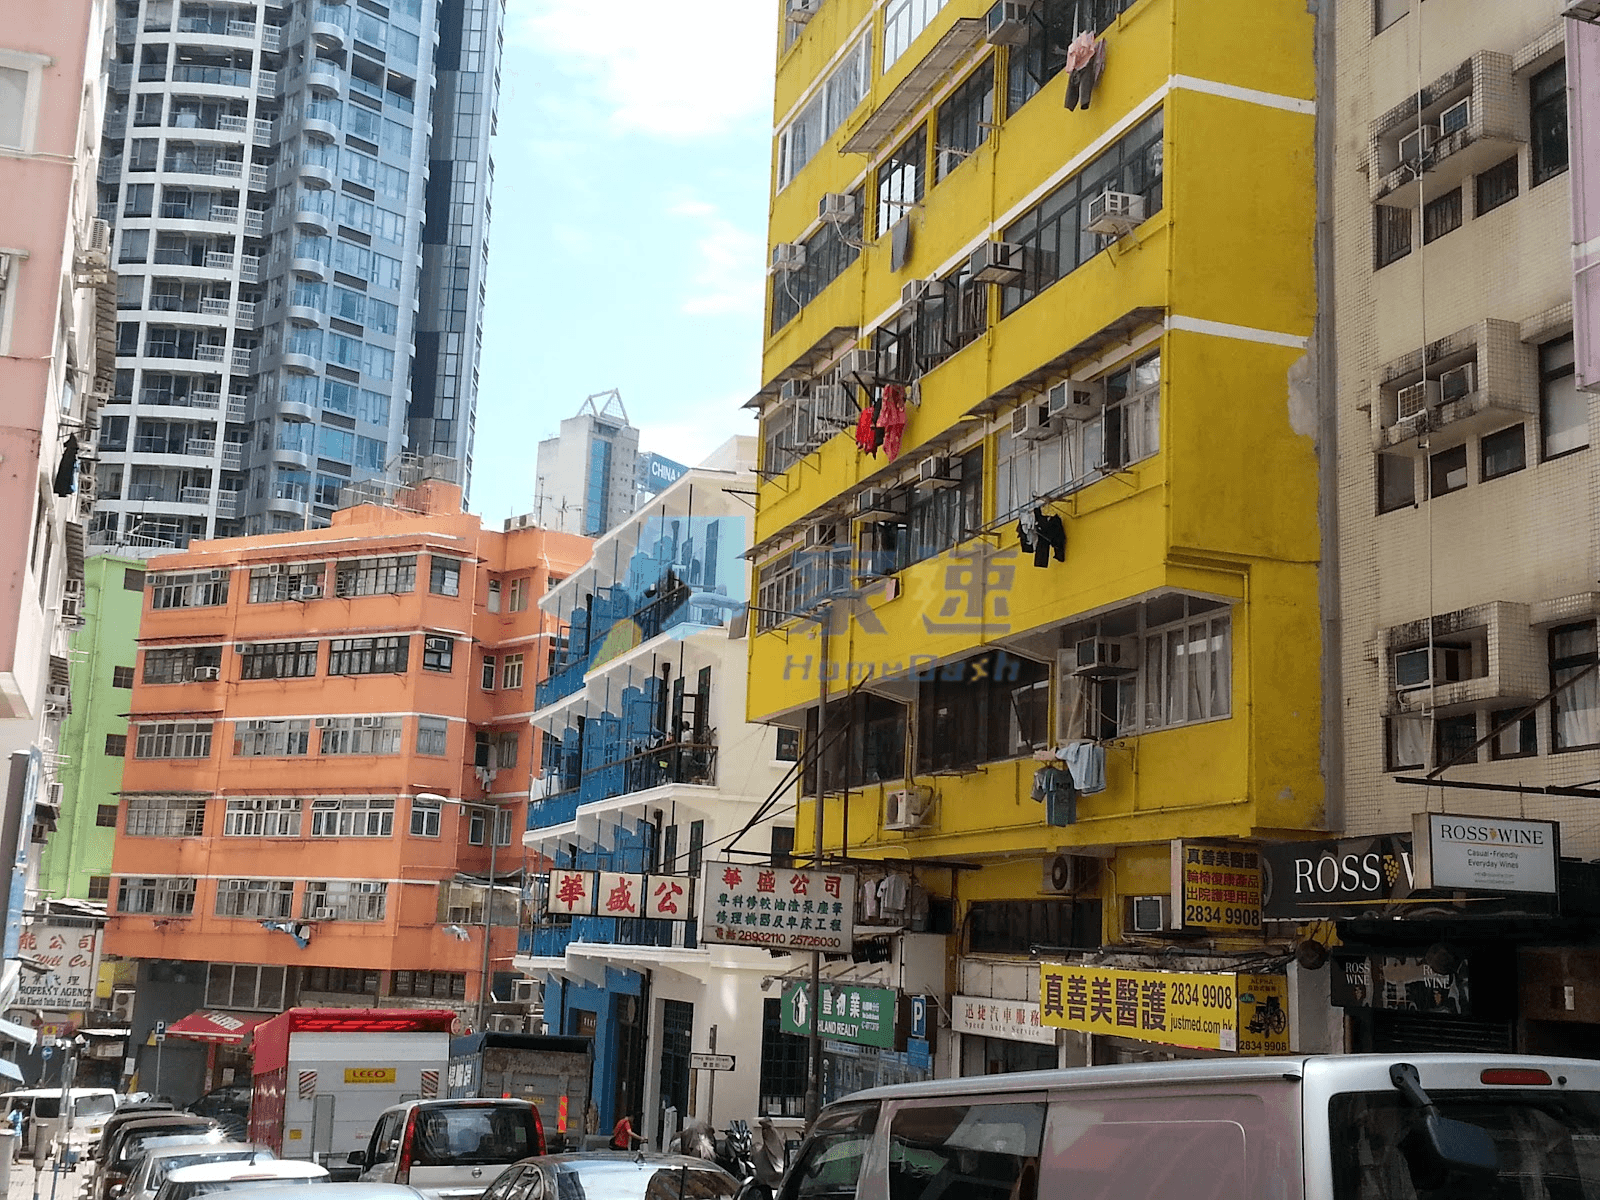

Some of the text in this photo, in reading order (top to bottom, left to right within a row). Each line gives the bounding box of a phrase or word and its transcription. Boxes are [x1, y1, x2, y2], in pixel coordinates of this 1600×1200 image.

[652, 461, 676, 482] CHINA
[1441, 824, 1544, 845] ROSS WINE
[1187, 848, 1260, 869] 真善美醫護
[1468, 859, 1519, 869] Everyday Wines
[722, 866, 842, 899] 華盛公司
[1294, 853, 1381, 894] ROSS
[555, 873, 684, 915] 華盛公
[1186, 905, 1260, 926] 2834 9908
[738, 930, 786, 944] 28932110
[790, 935, 841, 948] 25726030
[68, 954, 92, 968] Co.
[1345, 962, 1371, 974] ROSS
[1345, 973, 1371, 986] WINE
[1423, 974, 1450, 990] WINE
[809, 988, 861, 1020] 豐物業
[1044, 973, 1167, 1032] 真善美醫護
[1170, 982, 1232, 1010] 2834 9908
[156, 1021, 165, 1033] P
[913, 1001, 923, 1032] P
[1170, 1012, 1233, 1035] justmed.comhk
[837, 1021, 860, 1038] REALTY
[964, 1021, 1040, 1037] Speed Auto Service
[1240, 1041, 1287, 1051] 2834 9908
